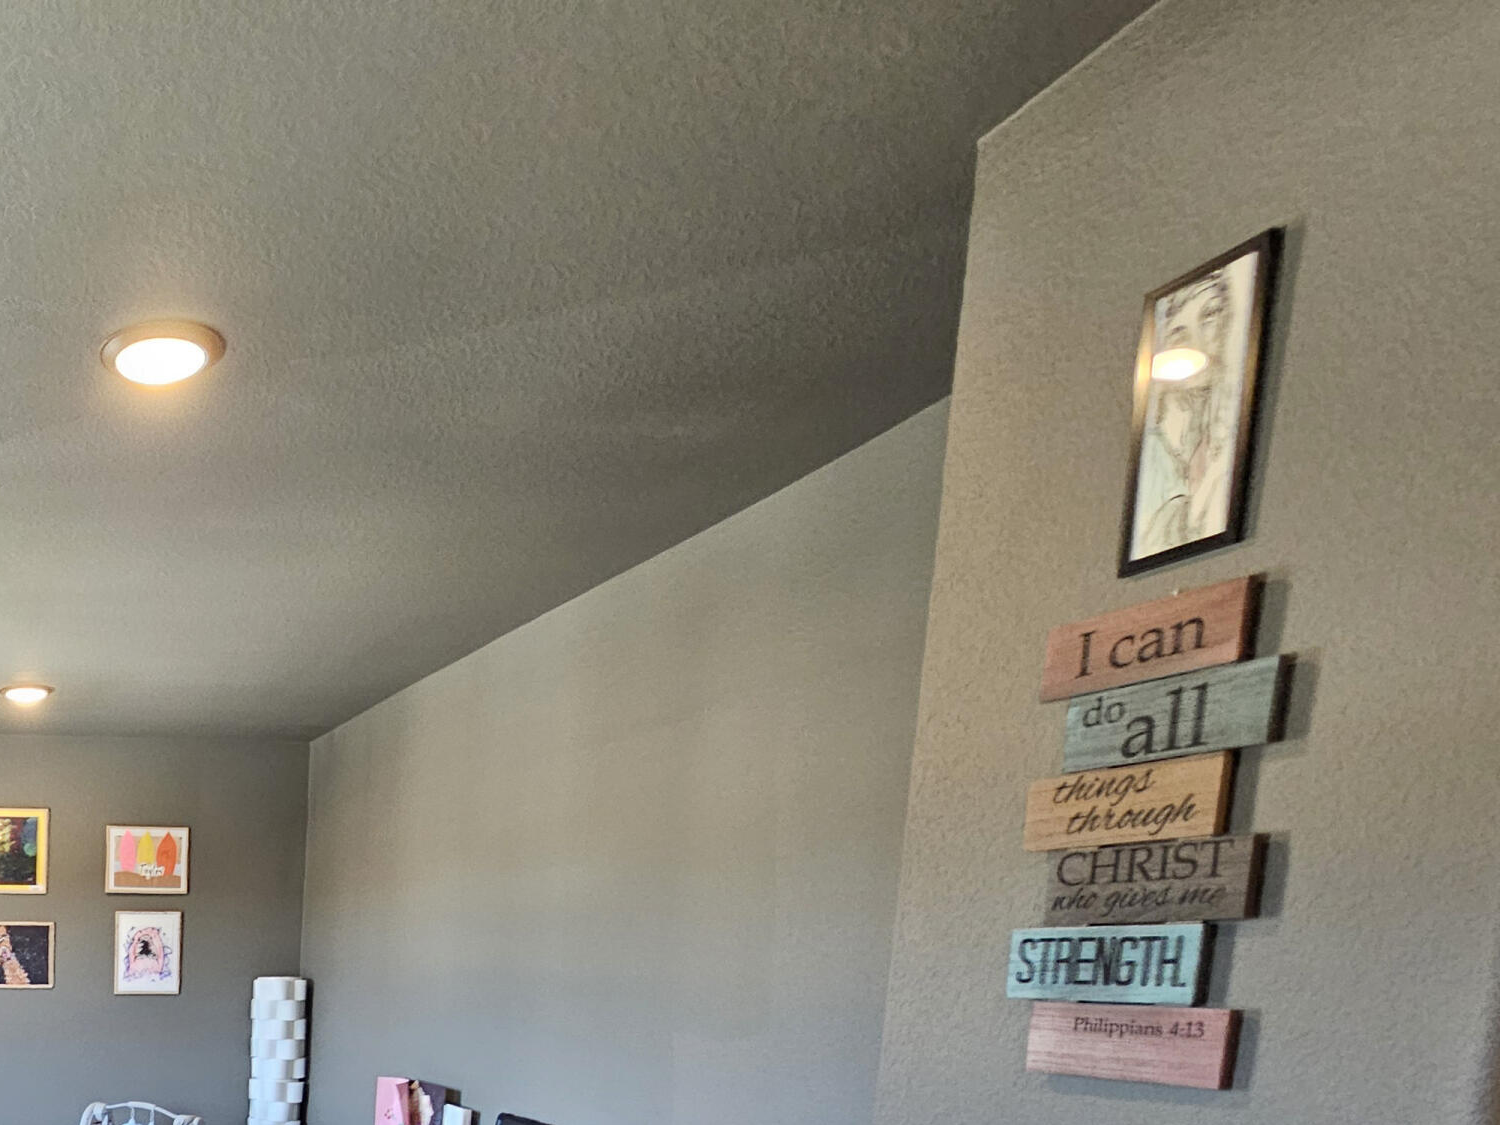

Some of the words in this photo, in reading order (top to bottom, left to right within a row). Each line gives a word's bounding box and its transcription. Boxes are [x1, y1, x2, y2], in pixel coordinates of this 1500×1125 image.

[1074, 630, 1096, 679] I
[1109, 616, 1206, 669] can
[1081, 696, 1127, 728] do
[1121, 682, 1210, 759] all
[1053, 768, 1156, 806] things
[1066, 793, 1199, 836] through
[1056, 838, 1235, 886] CHRIST
[1051, 887, 1097, 911] who
[1101, 884, 1169, 917] gives
[1178, 885, 1227, 905] me
[1073, 1016, 1164, 1038] Philippians
[1168, 1020, 1205, 1038] 4:13
